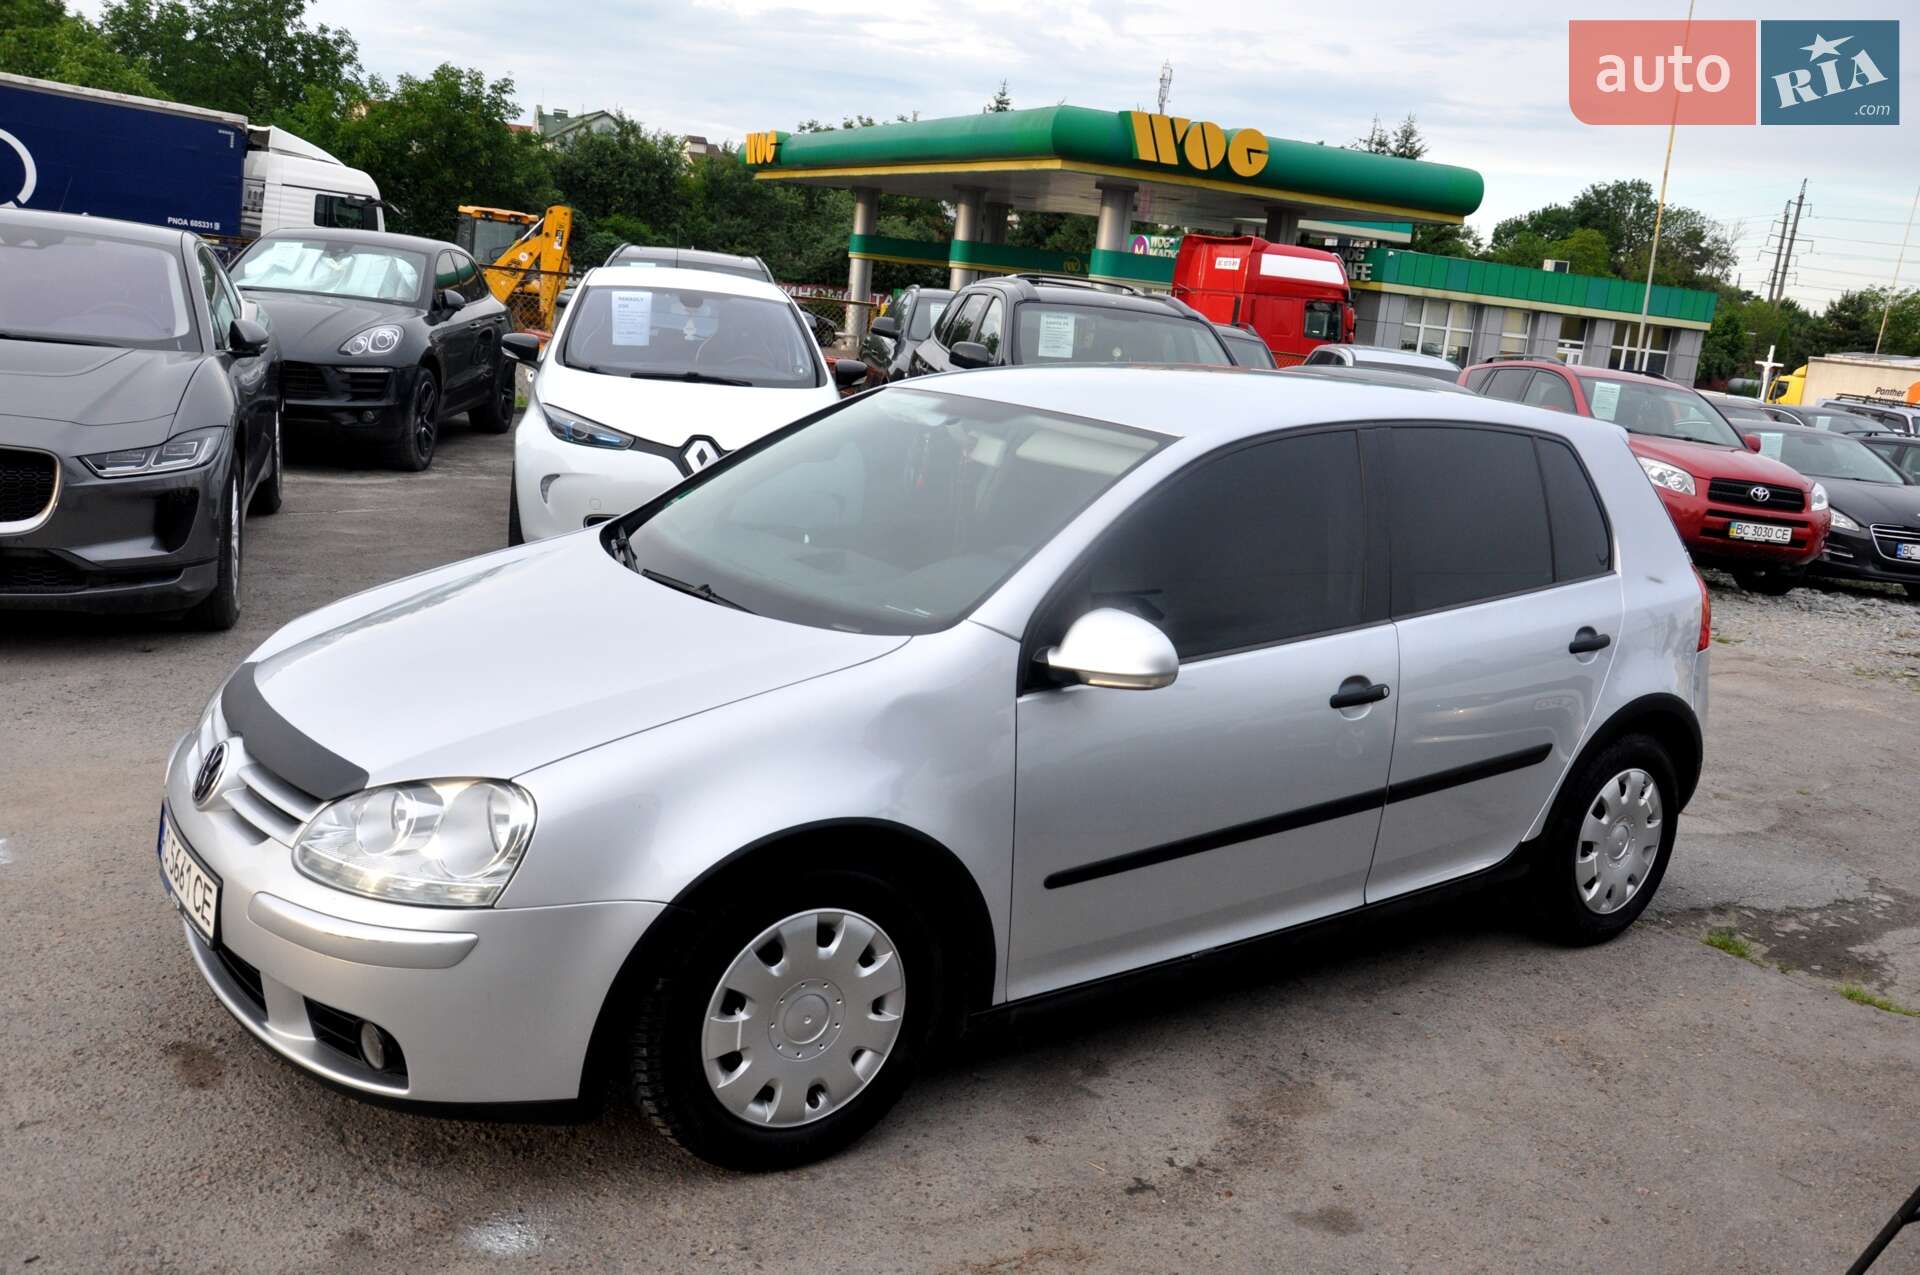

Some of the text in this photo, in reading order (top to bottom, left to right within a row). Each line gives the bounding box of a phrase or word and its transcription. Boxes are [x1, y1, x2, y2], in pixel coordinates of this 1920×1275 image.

[1130, 111, 1269, 177] WOG
[1345, 262, 1373, 281] AFE
[1875, 386, 1906, 397] Panther
[1736, 524, 1790, 540] BC 3030 CE
[193, 873, 213, 927] CE
